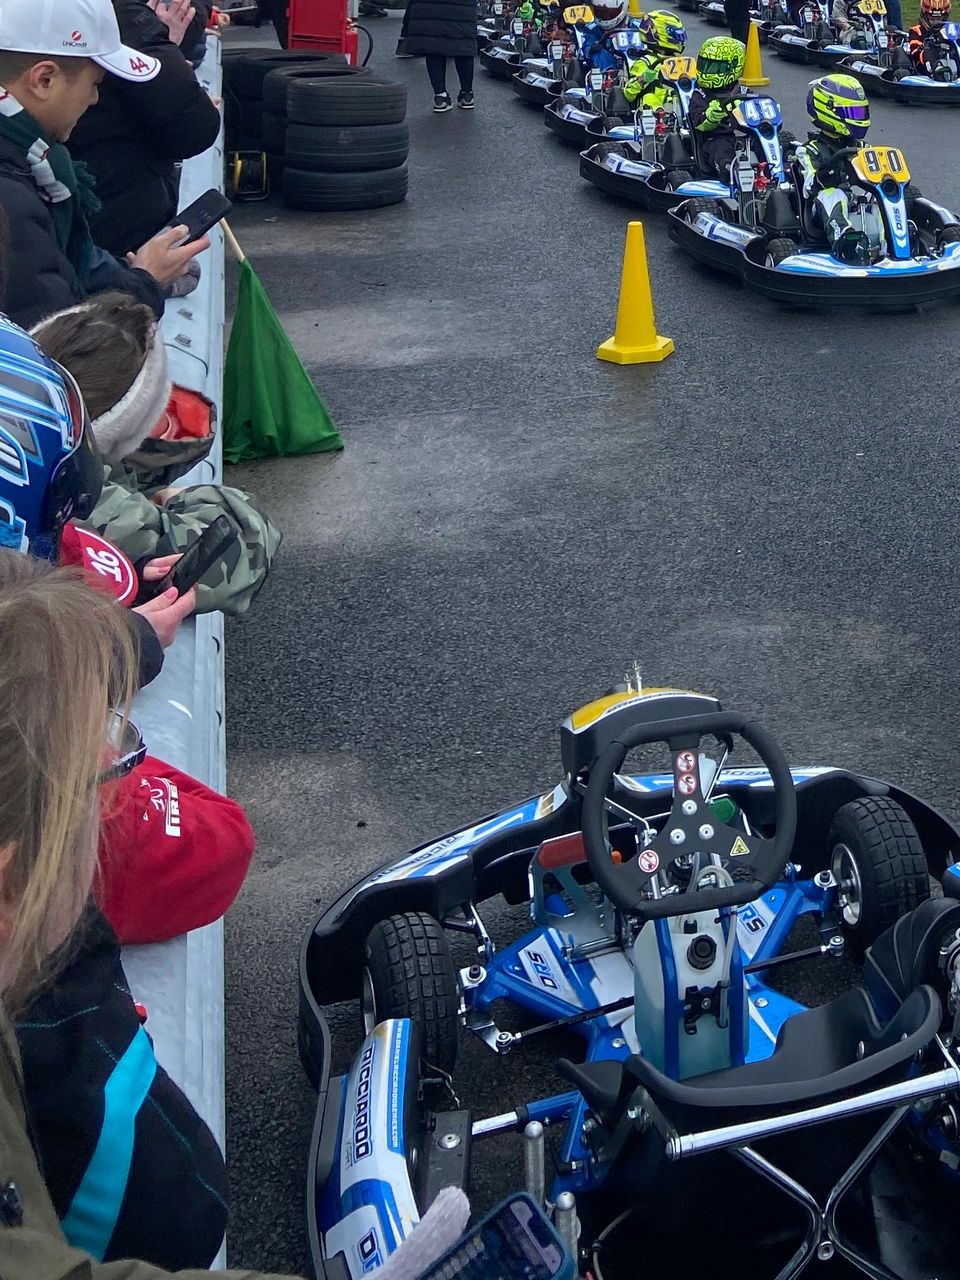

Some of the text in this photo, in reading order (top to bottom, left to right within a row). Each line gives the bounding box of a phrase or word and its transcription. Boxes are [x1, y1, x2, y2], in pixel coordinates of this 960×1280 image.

[570, 6, 587, 19] 47
[129, 56, 150, 73] 44
[667, 58, 693, 75] 27
[745, 98, 777, 121] 45
[864, 149, 903, 174] 90
[86, 546, 122, 583] 16
[526, 951, 559, 990] DRS
[354, 1046, 374, 1161] RICCIARDO
